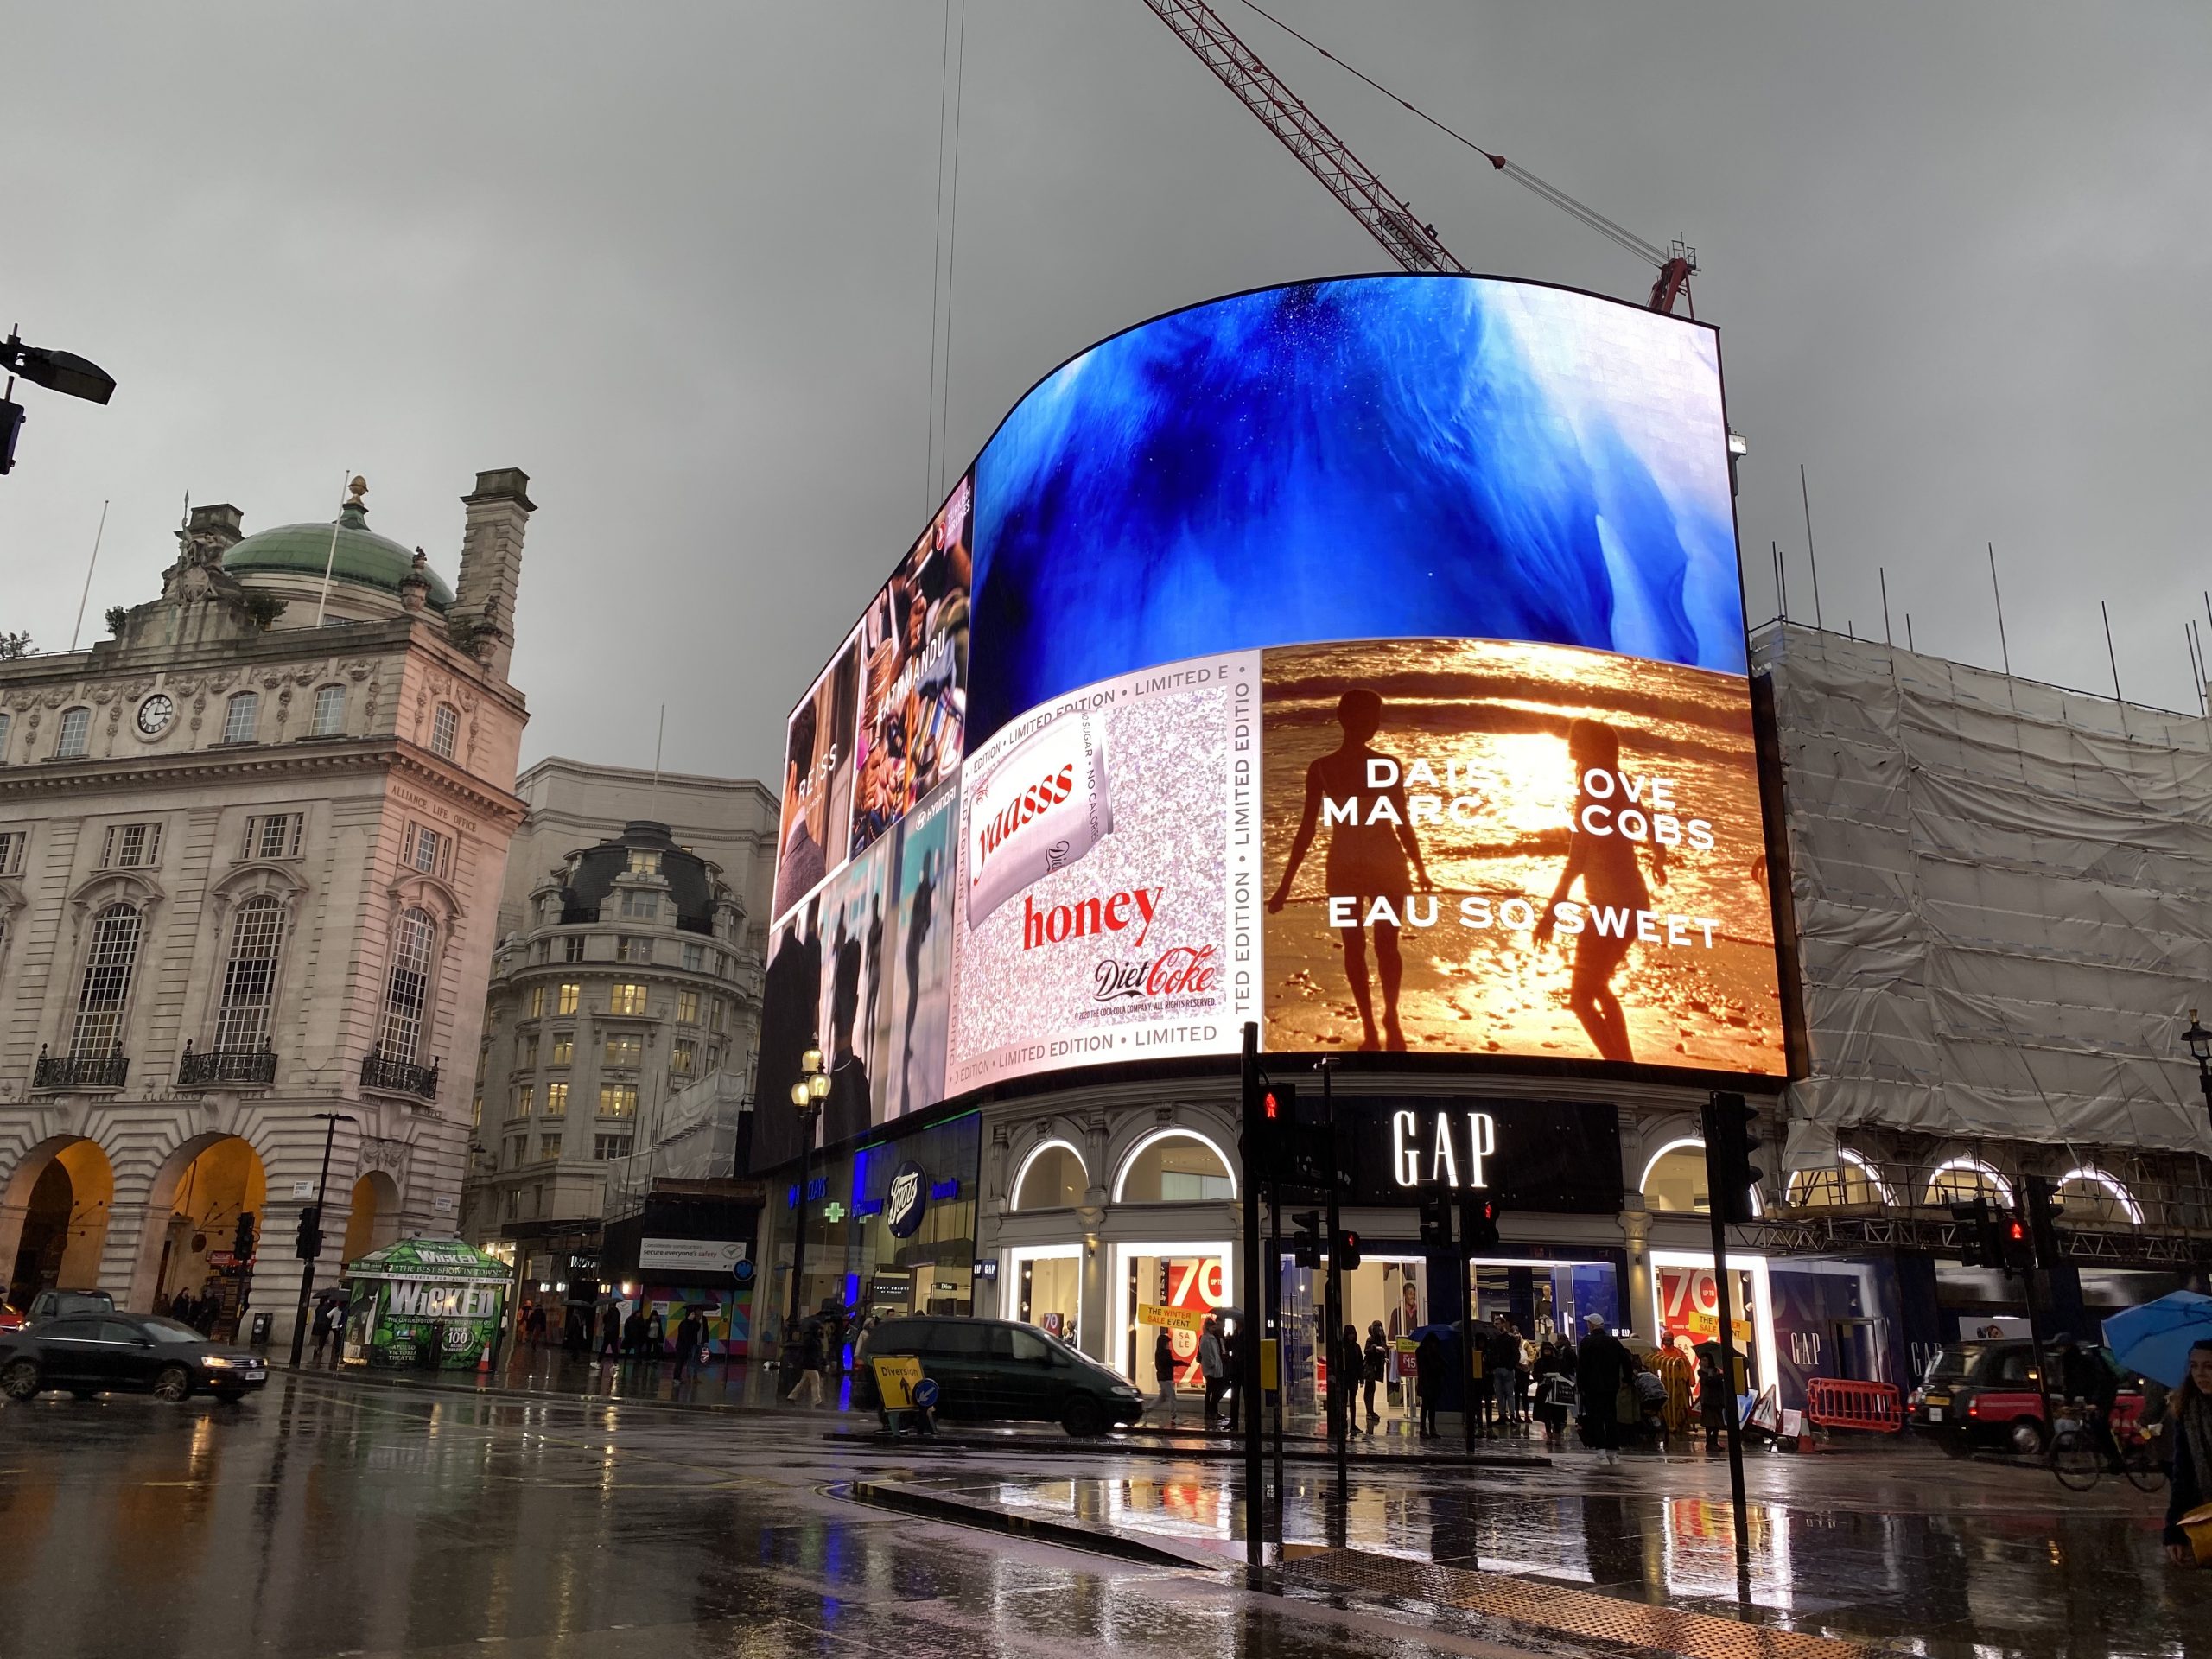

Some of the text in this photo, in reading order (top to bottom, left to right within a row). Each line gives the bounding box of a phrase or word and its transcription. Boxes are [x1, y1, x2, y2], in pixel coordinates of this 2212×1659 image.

[973, 742, 1001, 773] EDITION
[1009, 713, 1052, 744] LIMITED
[1135, 668, 1211, 696] LIMITED
[1218, 664, 1229, 680] E
[1082, 722, 1093, 757] SUGAR
[798, 743, 837, 805] REISS
[1087, 769, 1096, 790] NO
[391, 785, 477, 832] ALLIANCE LIFE OFFICE
[927, 785, 957, 820] HYUNDAI
[1323, 794, 1484, 827] MARC
[973, 763, 1073, 886] yaasss
[1235, 682, 1250, 1014] TED EDITION LIMITED EDITIO
[1023, 886, 1165, 951] honey
[1329, 895, 1719, 950] EAU SO SWEET
[1093, 944, 1220, 1002] Diet Coke
[1090, 1008, 1100, 1018] THE
[1100, 1006, 1127, 1017] COCA-COLA
[1154, 1001, 1164, 1010] ALL
[1166, 1000, 1185, 1009] RIGHTS
[961, 1026, 1217, 1082] EDITION LIMITED EDITION LIMITED
[1393, 1109, 1496, 1189] GAP
[888, 1171, 918, 1225] Boots
[437, 1267, 462, 1275] SHOW
[984, 1264, 995, 1274] GAP
[1170, 1258, 1222, 1308] 70
[1662, 1268, 1719, 1318] 70
[1045, 1313, 1058, 1329] 70
[1147, 1307, 1162, 1316] THE
[1164, 1309, 1192, 1319] WINTER
[1147, 1315, 1191, 1328] SALE EVENT
[1700, 1315, 1713, 1325] THE
[1700, 1324, 1718, 1333] SALE
[448, 1332, 467, 1344] 100
[1790, 1332, 1821, 1365] GAP
[880, 1366, 918, 1376] Diversion
